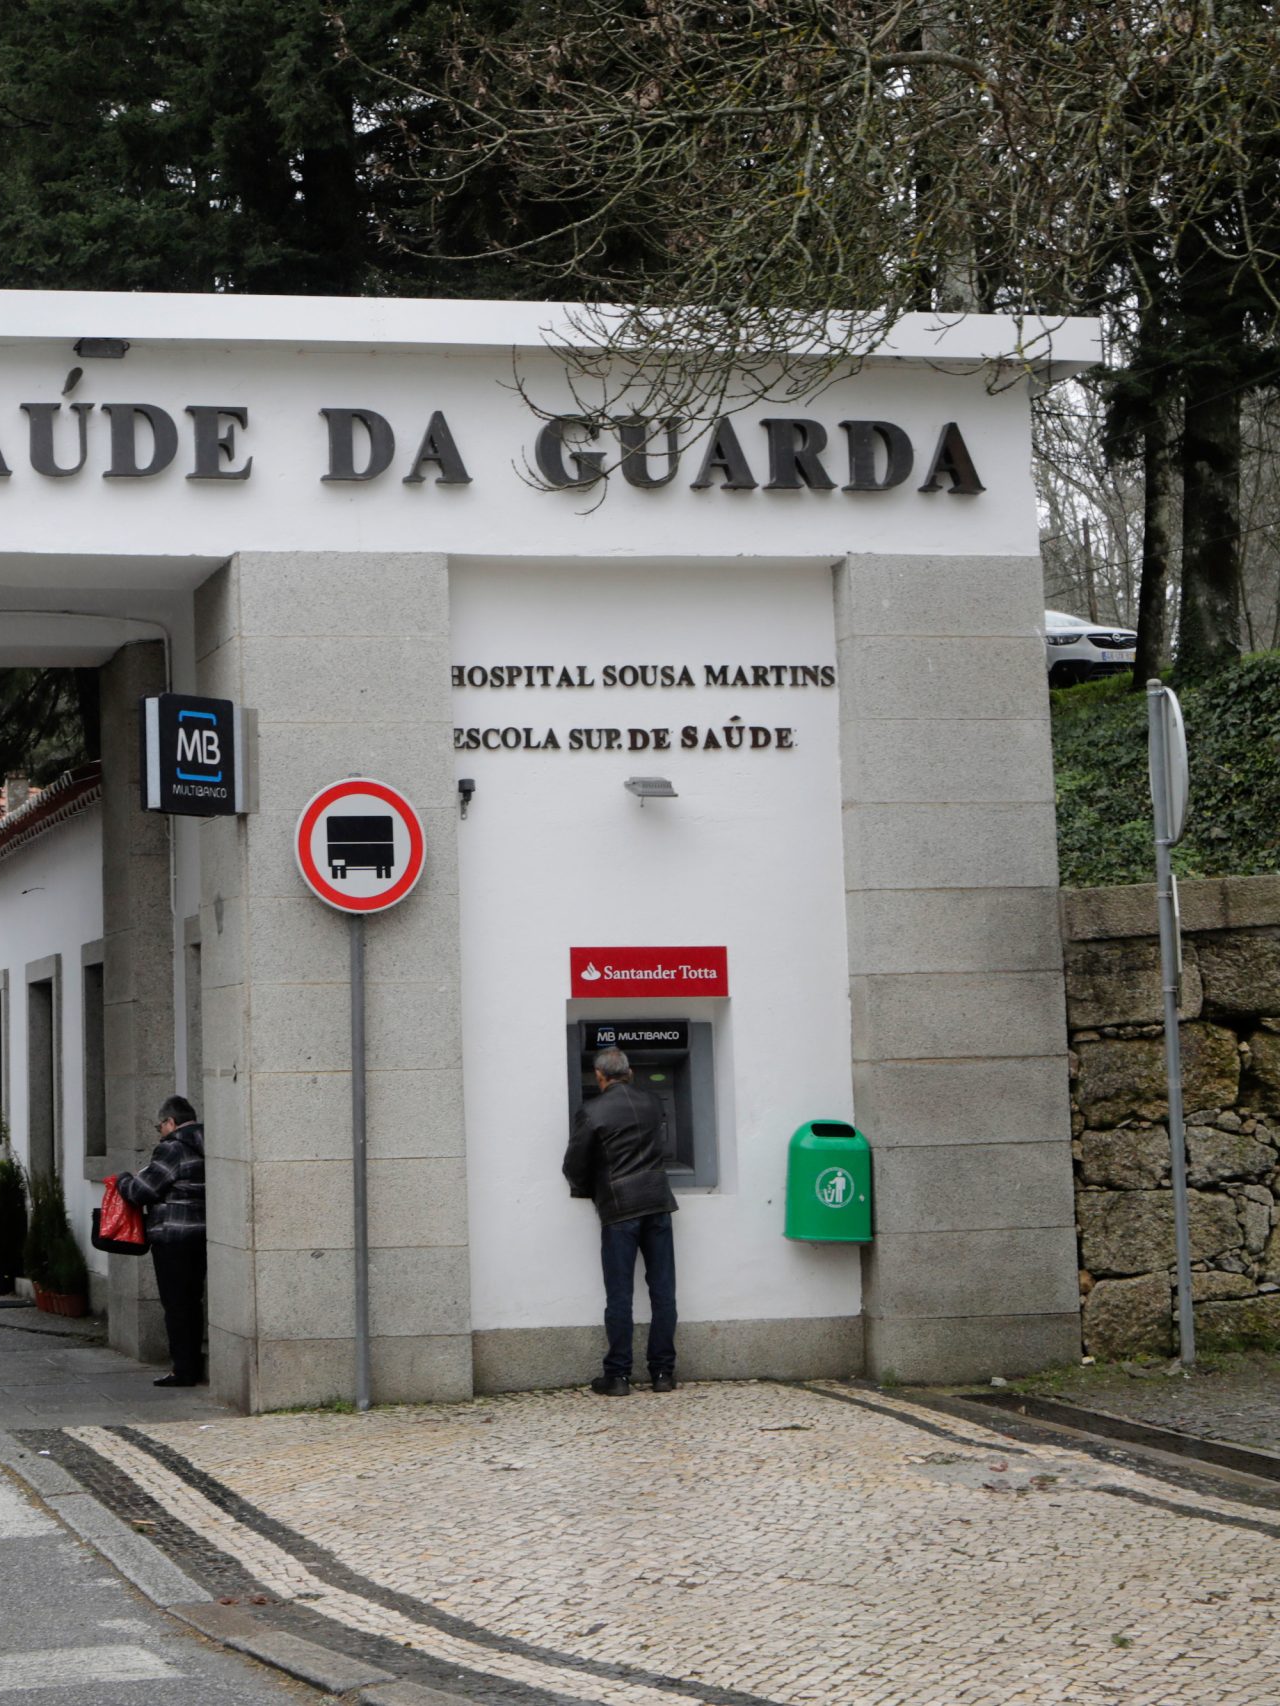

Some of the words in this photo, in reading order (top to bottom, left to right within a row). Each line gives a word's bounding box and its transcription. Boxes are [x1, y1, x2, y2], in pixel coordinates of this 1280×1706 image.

[319, 407, 473, 485] DA
[534, 413, 987, 496] GUARDA
[452, 665, 595, 688] HOSPITAL
[602, 665, 696, 688] SOUSA
[704, 664, 836, 688] MARTINS
[454, 727, 561, 750] ESCOLA
[568, 727, 623, 750] SUP.
[627, 728, 671, 751] DE
[680, 715, 795, 751] SAÚDE
[176, 727, 221, 765] MB
[173, 784, 227, 798] MULTIBANCO
[603, 964, 677, 980] Santander
[678, 964, 718, 979] Totta
[596, 1031, 616, 1042] MB
[618, 1031, 680, 1041] MULTIBANCO
